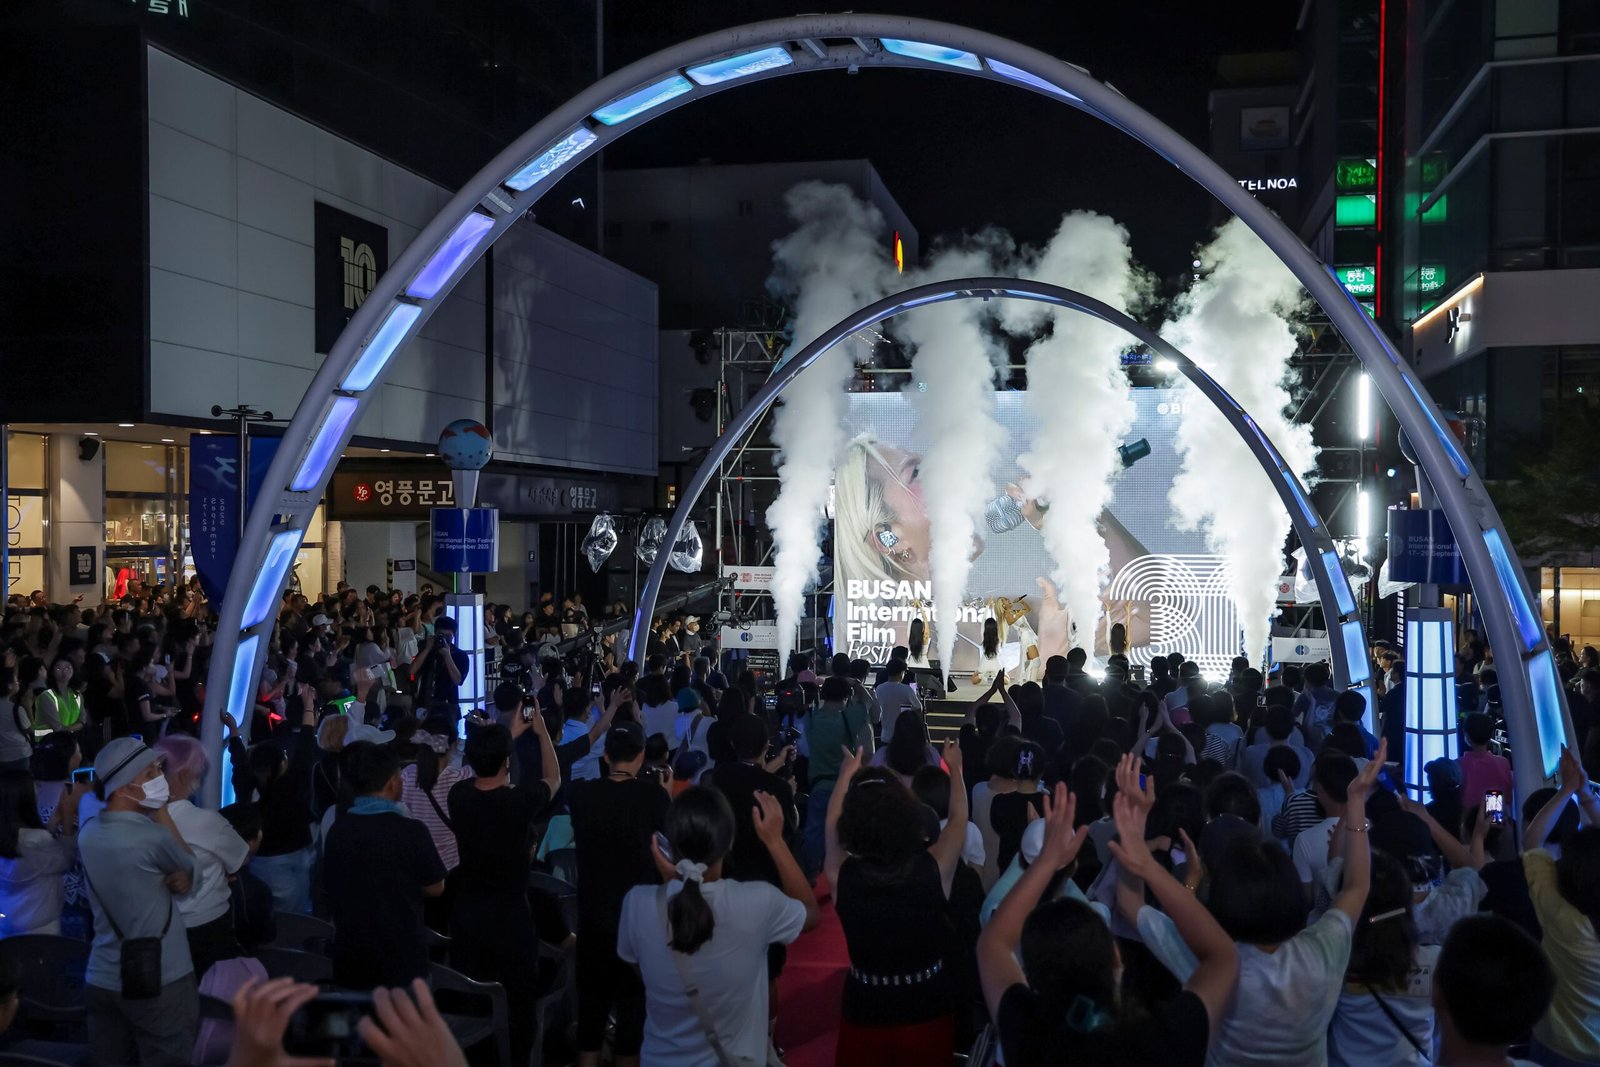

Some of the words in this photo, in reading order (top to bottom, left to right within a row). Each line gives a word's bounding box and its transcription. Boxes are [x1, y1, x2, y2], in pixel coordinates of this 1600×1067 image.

[374, 480, 455, 506] 영풍문고
[569, 486, 597, 509] 영풍문고
[847, 580, 932, 600] BUSAN
[847, 622, 896, 644] Film
